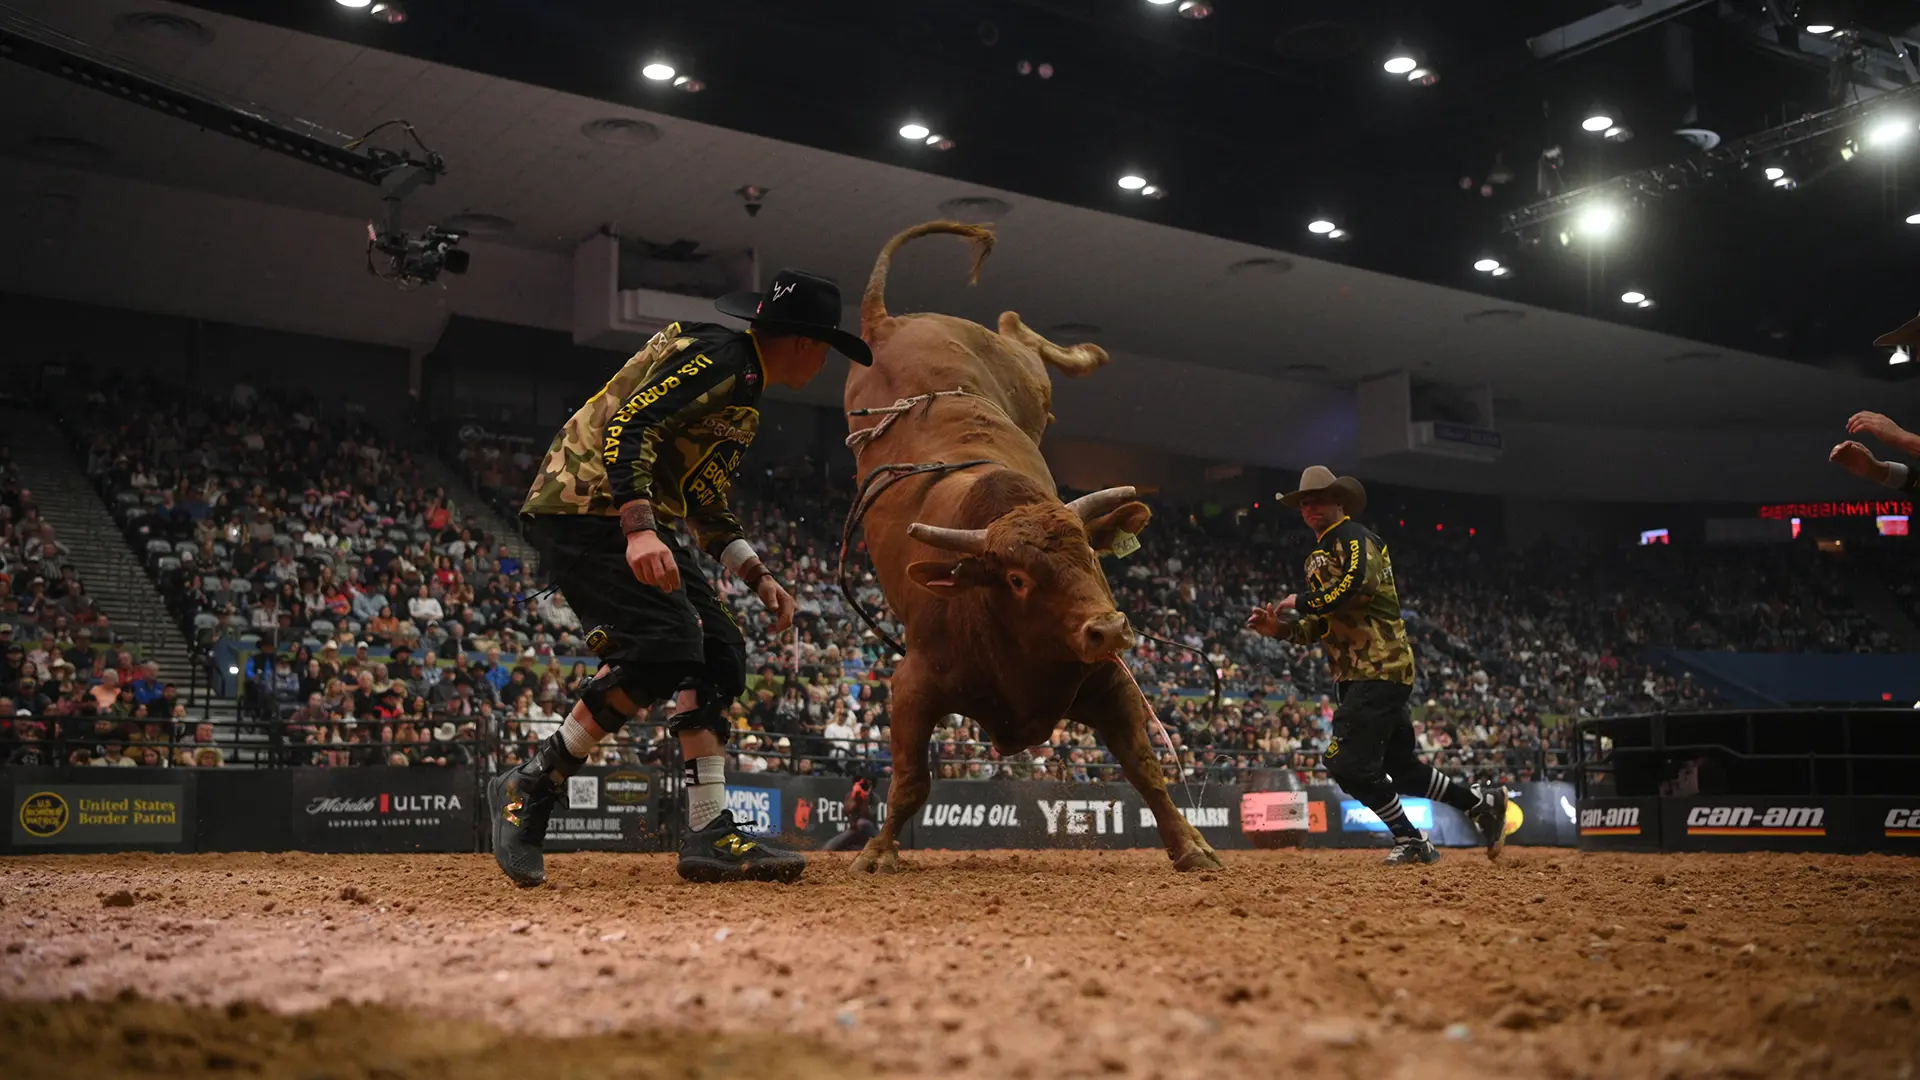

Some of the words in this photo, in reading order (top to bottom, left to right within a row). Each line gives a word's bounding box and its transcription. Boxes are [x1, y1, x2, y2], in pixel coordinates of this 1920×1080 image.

[677, 353, 714, 377] U.S.
[612, 375, 681, 424] BORDER
[604, 425, 624, 465] PAT
[79, 798, 129, 811] United
[133, 798, 176, 811] States
[305, 797, 377, 815] Michelob
[393, 794, 463, 812] ULTRA
[724, 789, 770, 811] MPING
[79, 811, 129, 825] Border
[133, 812, 176, 825] Patrol
[328, 819, 378, 828] SUPERIOR
[382, 818, 411, 827] LIGHT
[415, 818, 441, 826] BEER
[565, 818, 586, 832] ROCK
[586, 818, 603, 832] AND
[727, 808, 771, 833] ORLD
[922, 804, 986, 827] LUCAS
[988, 804, 1019, 827] OIL
[1037, 800, 1124, 835] YETI
[1185, 807, 1230, 828] BARN
[1579, 806, 1640, 827] can-am
[1687, 806, 1824, 827] can-am
